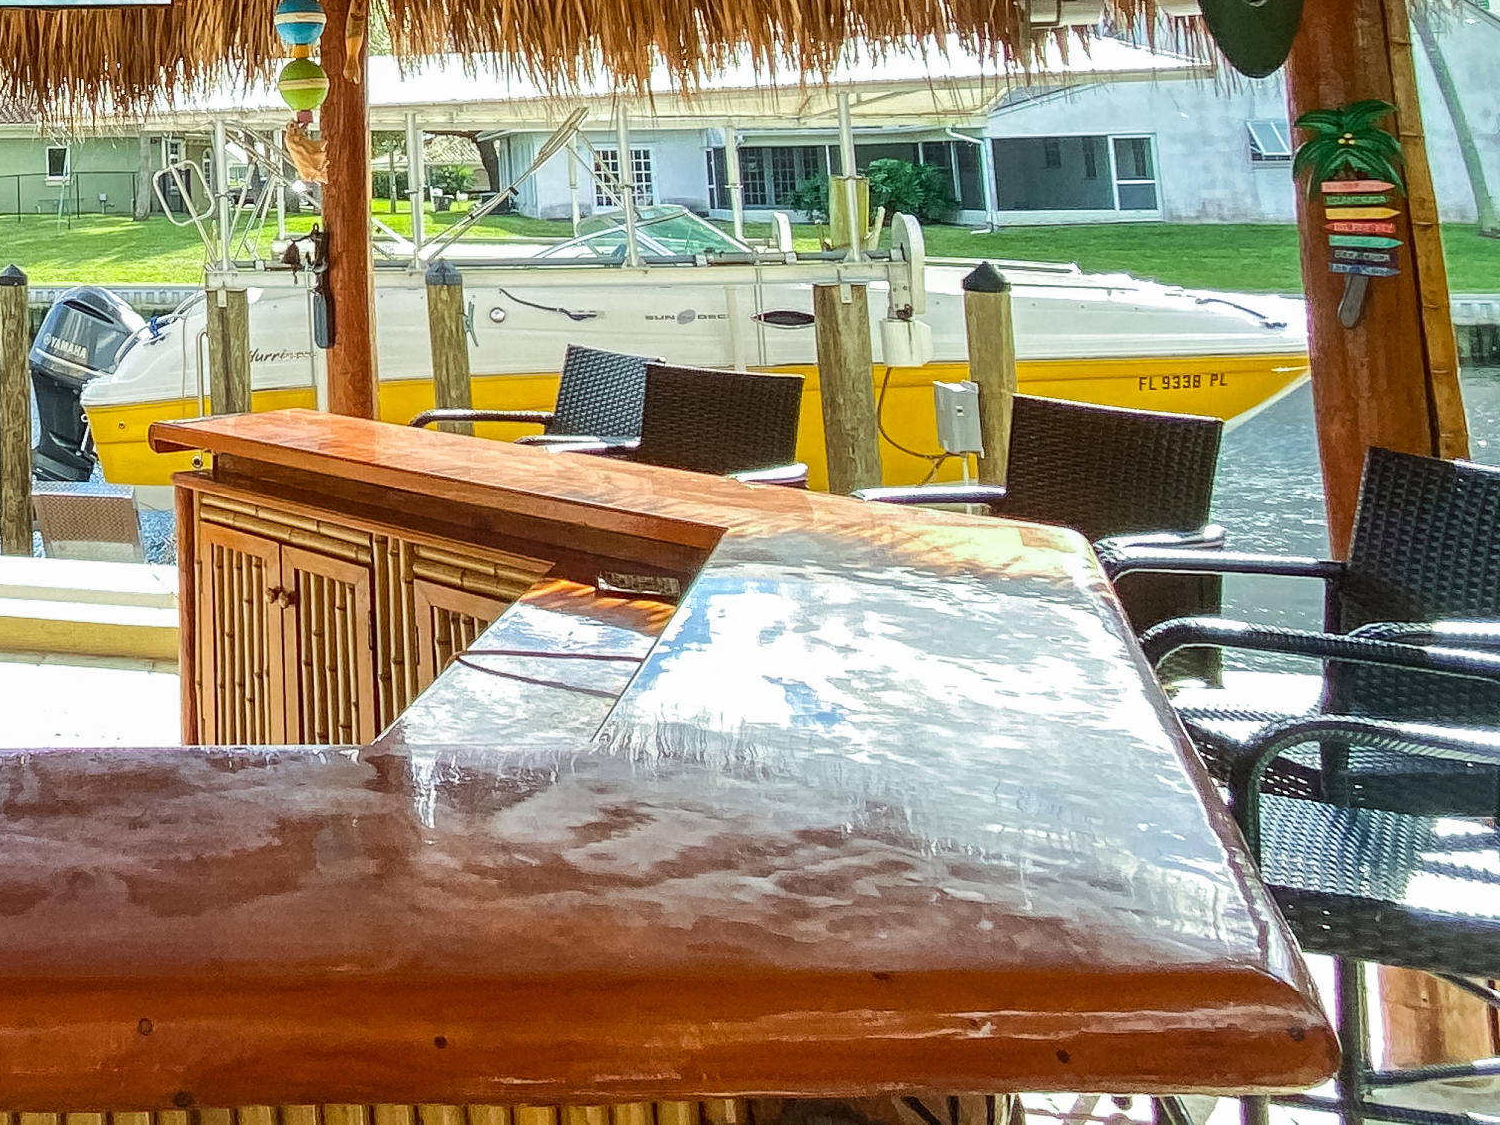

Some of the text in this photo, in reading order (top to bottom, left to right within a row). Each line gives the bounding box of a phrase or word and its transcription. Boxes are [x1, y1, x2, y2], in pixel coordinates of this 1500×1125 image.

[50, 336, 87, 359] YAMAHA
[1139, 373, 1227, 391] FL 9338 PL
